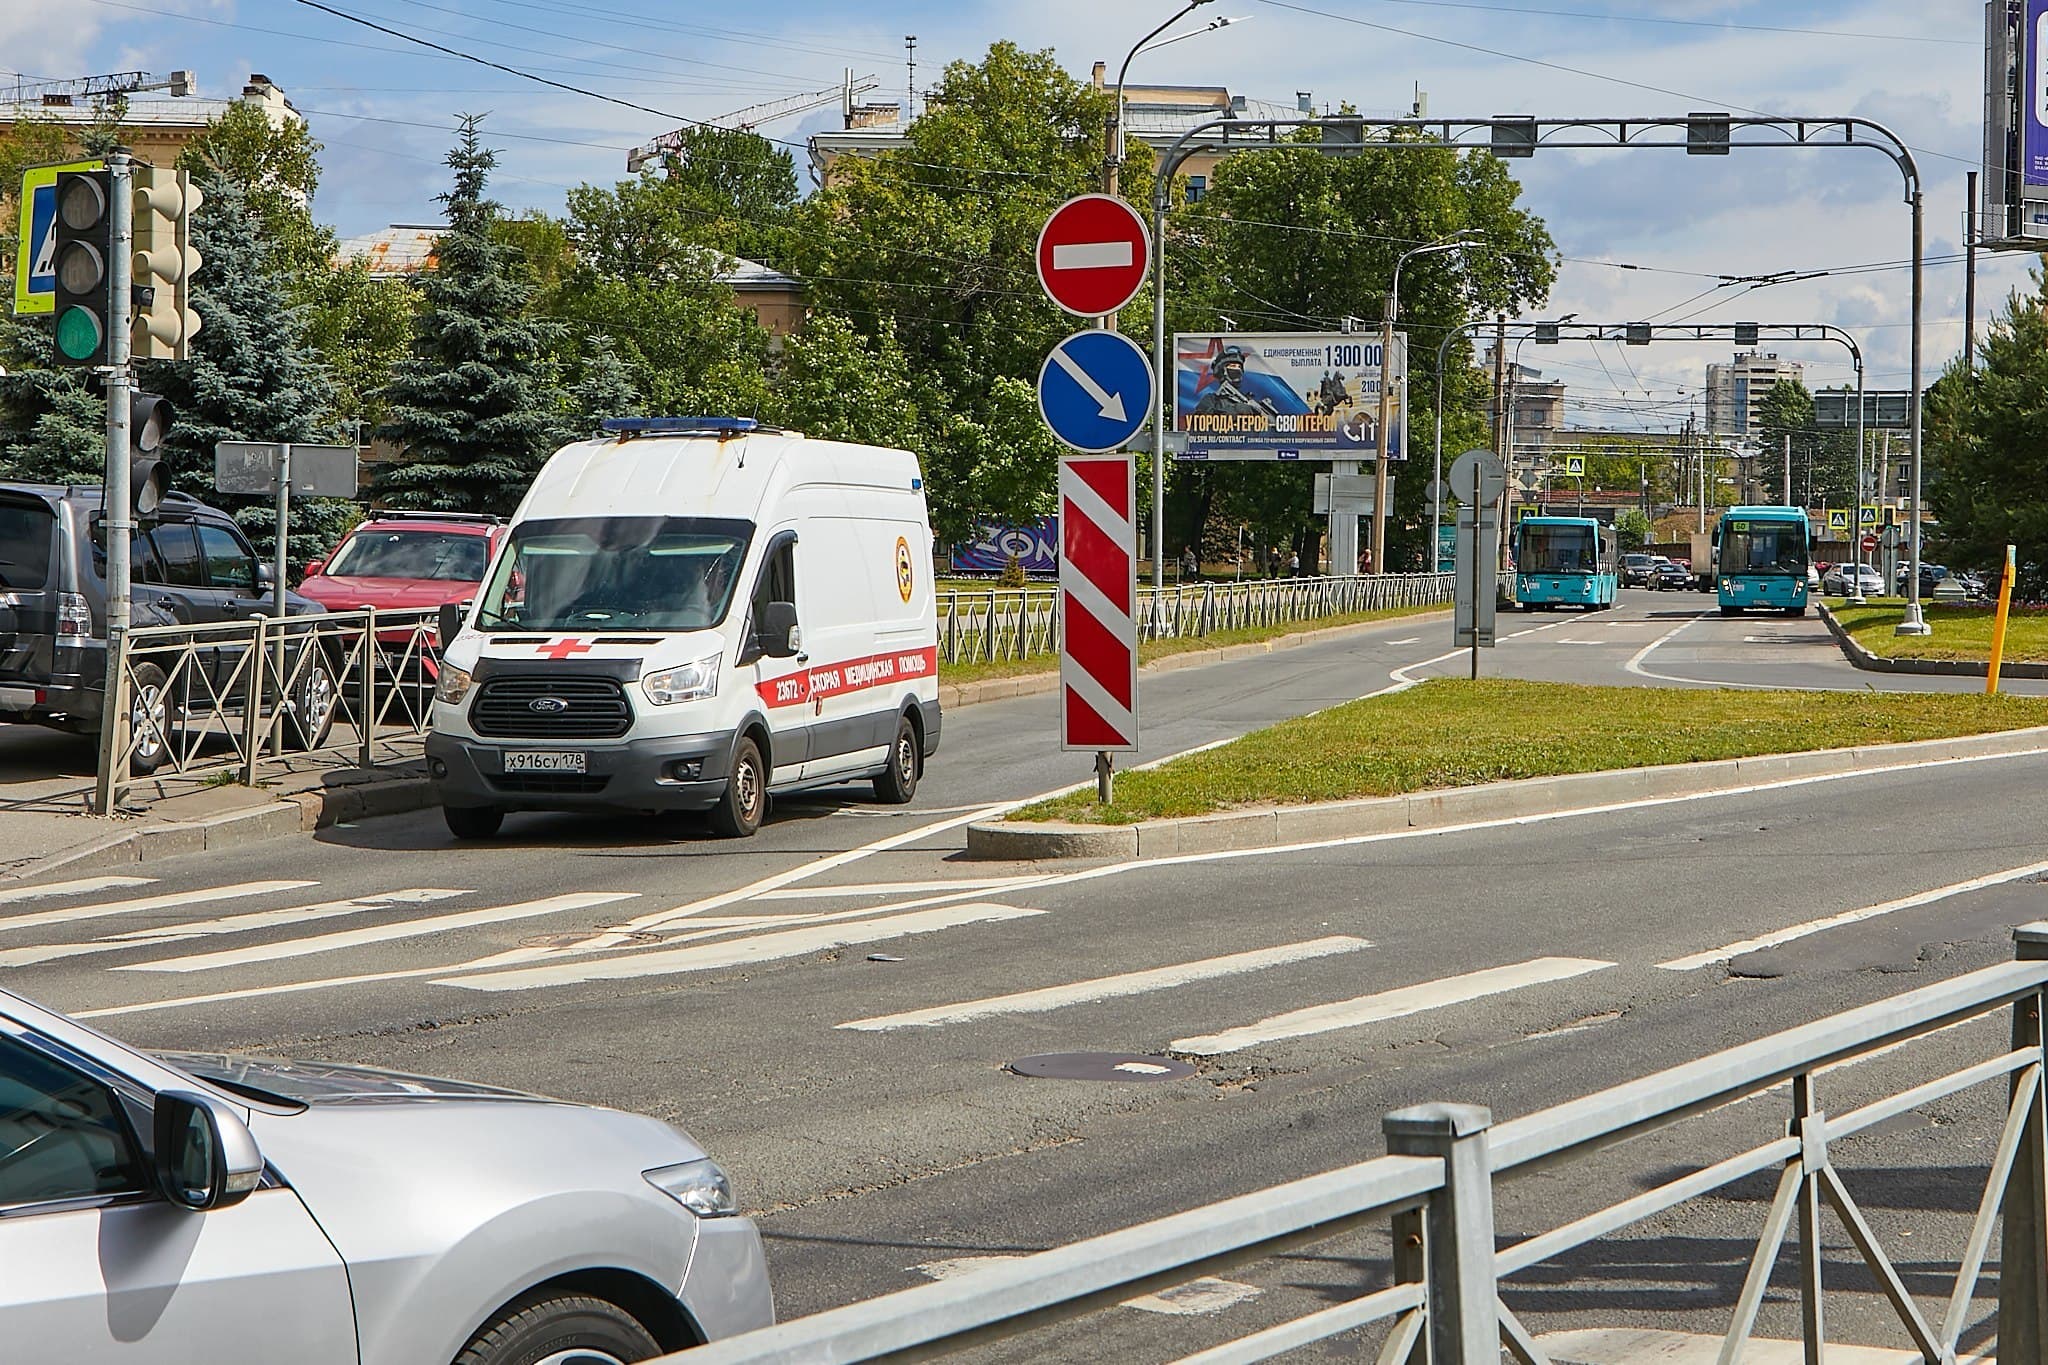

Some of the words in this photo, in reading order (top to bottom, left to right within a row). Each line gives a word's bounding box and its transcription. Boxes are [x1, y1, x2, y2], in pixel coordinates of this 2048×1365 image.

[1263, 348, 1322, 358] ЕДИНОВРЕМЕННАЯ
[1364, 345, 1382, 367] 00
[1291, 359, 1322, 367] ВЫПЛАТА
[1185, 414, 1193, 432] У
[1193, 414, 1269, 434] ГОРОДА-ГЕРОЯ
[1276, 415, 1304, 432] СВОИ
[1305, 415, 1338, 432] ГЕРОИ
[1359, 422, 1379, 441] 11
[1735, 522, 1746, 531] 60
[776, 679, 799, 701] 23672
[809, 670, 841, 694] СКОРАЯ
[844, 659, 894, 686] МЕДИЦИНСКАЯ
[898, 654, 927, 673] ПОМОЩЬ
[536, 701, 556, 711] Ford
[562, 754, 582, 765] 178
